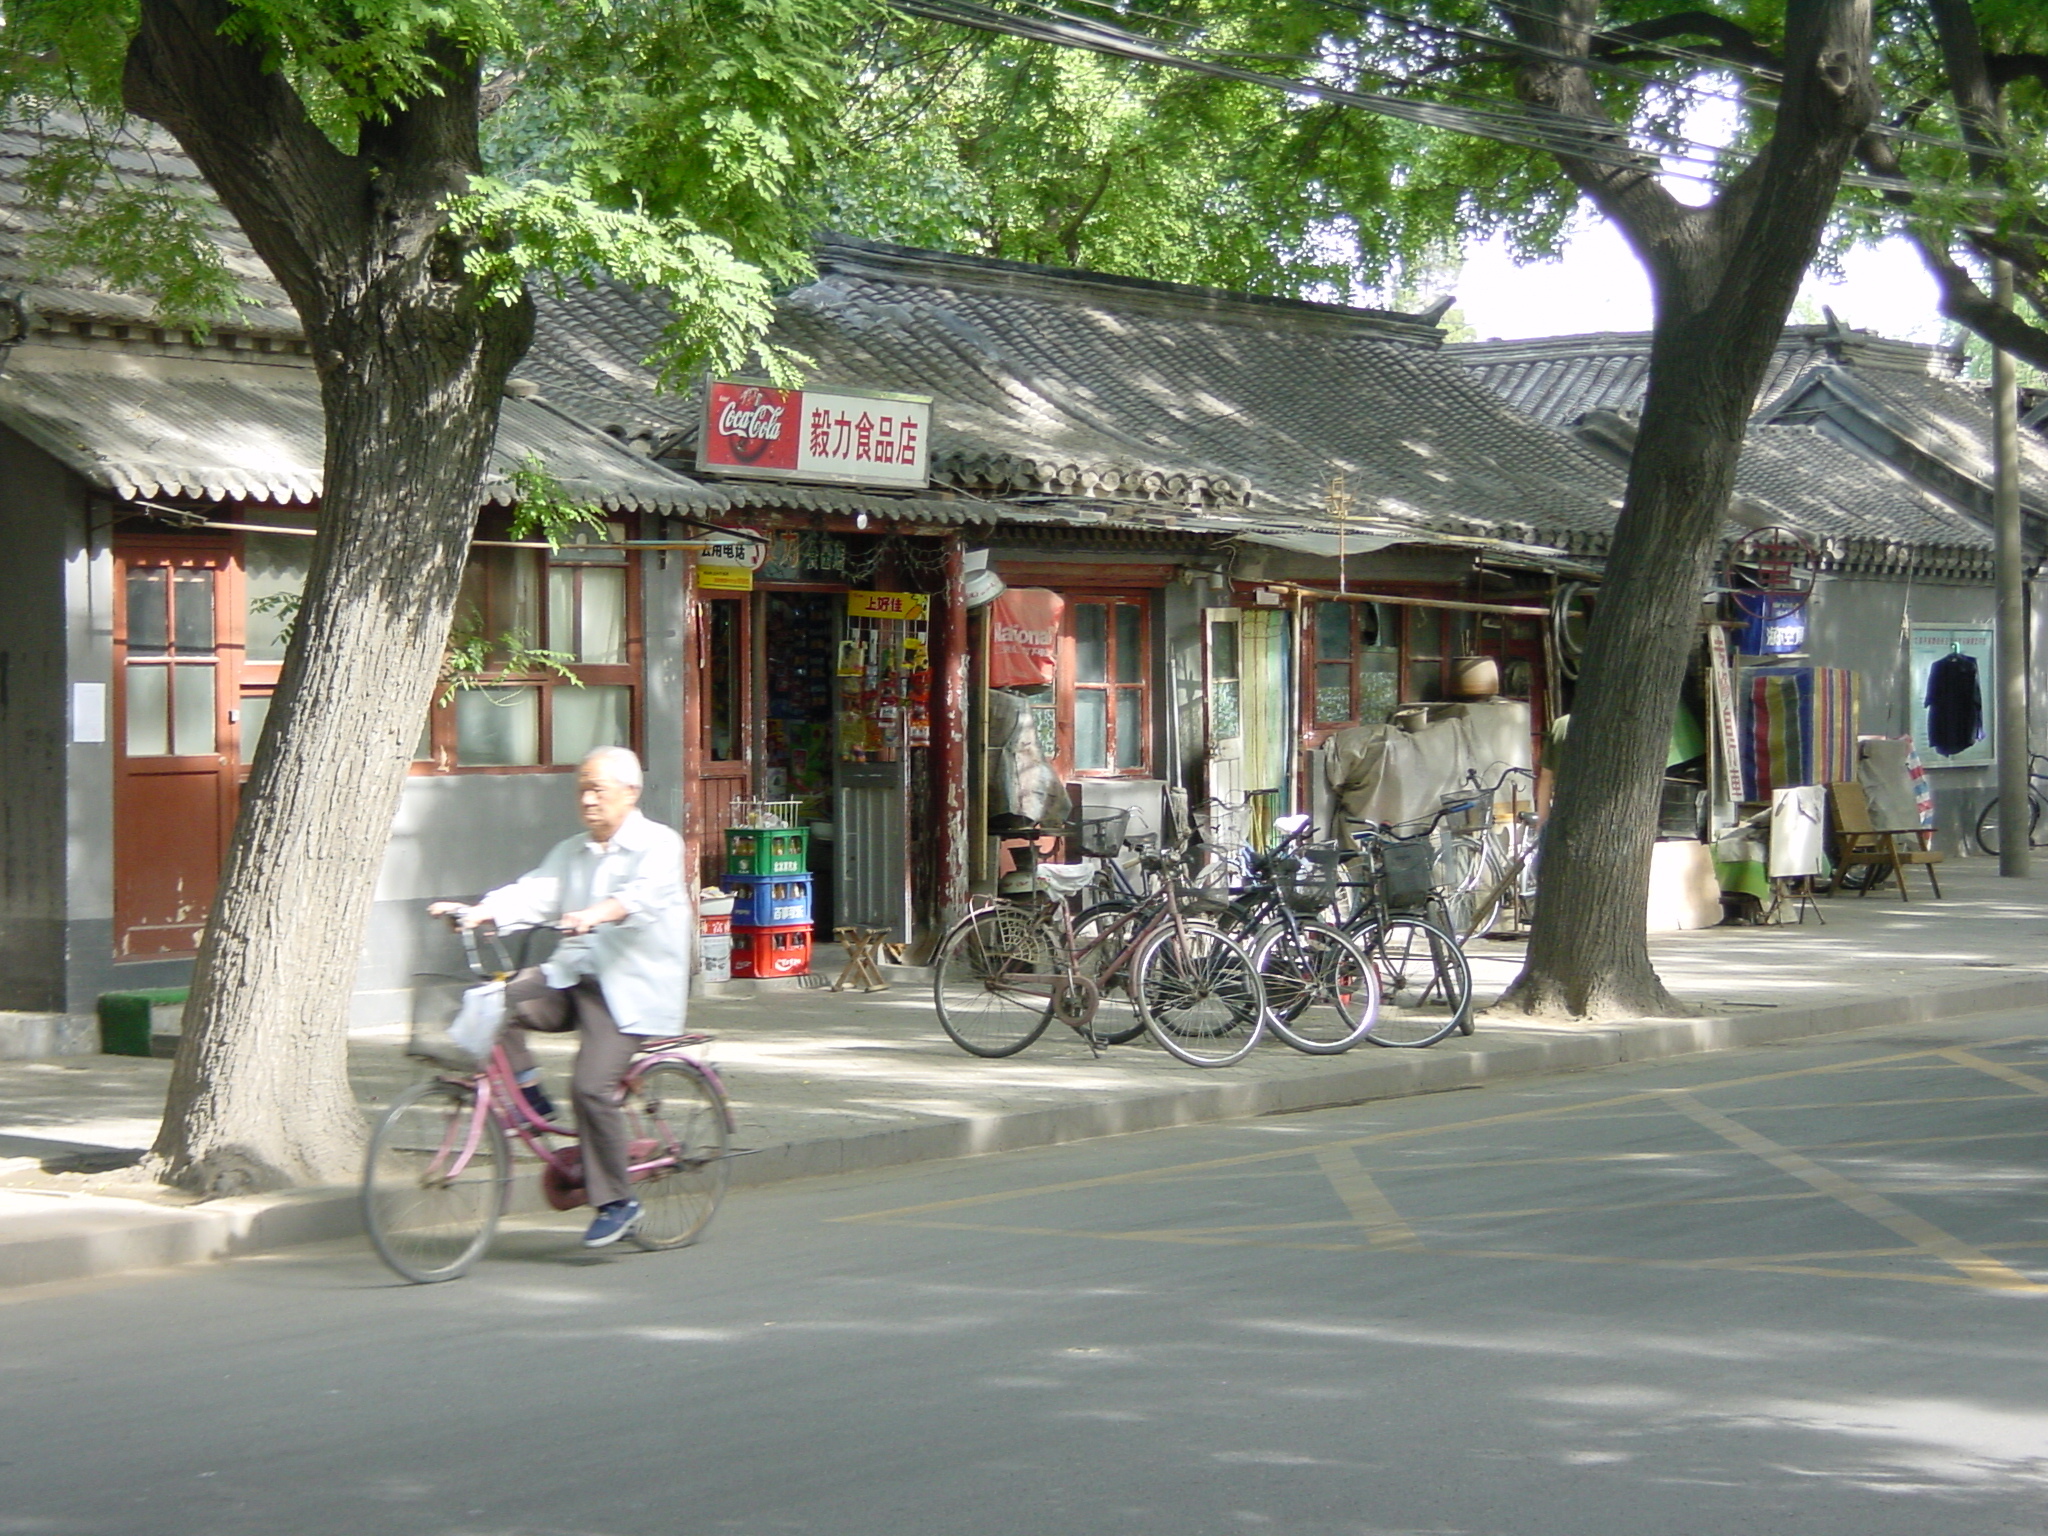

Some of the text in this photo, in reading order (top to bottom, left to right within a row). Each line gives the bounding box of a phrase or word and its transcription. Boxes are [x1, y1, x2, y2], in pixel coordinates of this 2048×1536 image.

[809, 407, 918, 465] 毅力食品店
[865, 596, 903, 613] 上好佳
